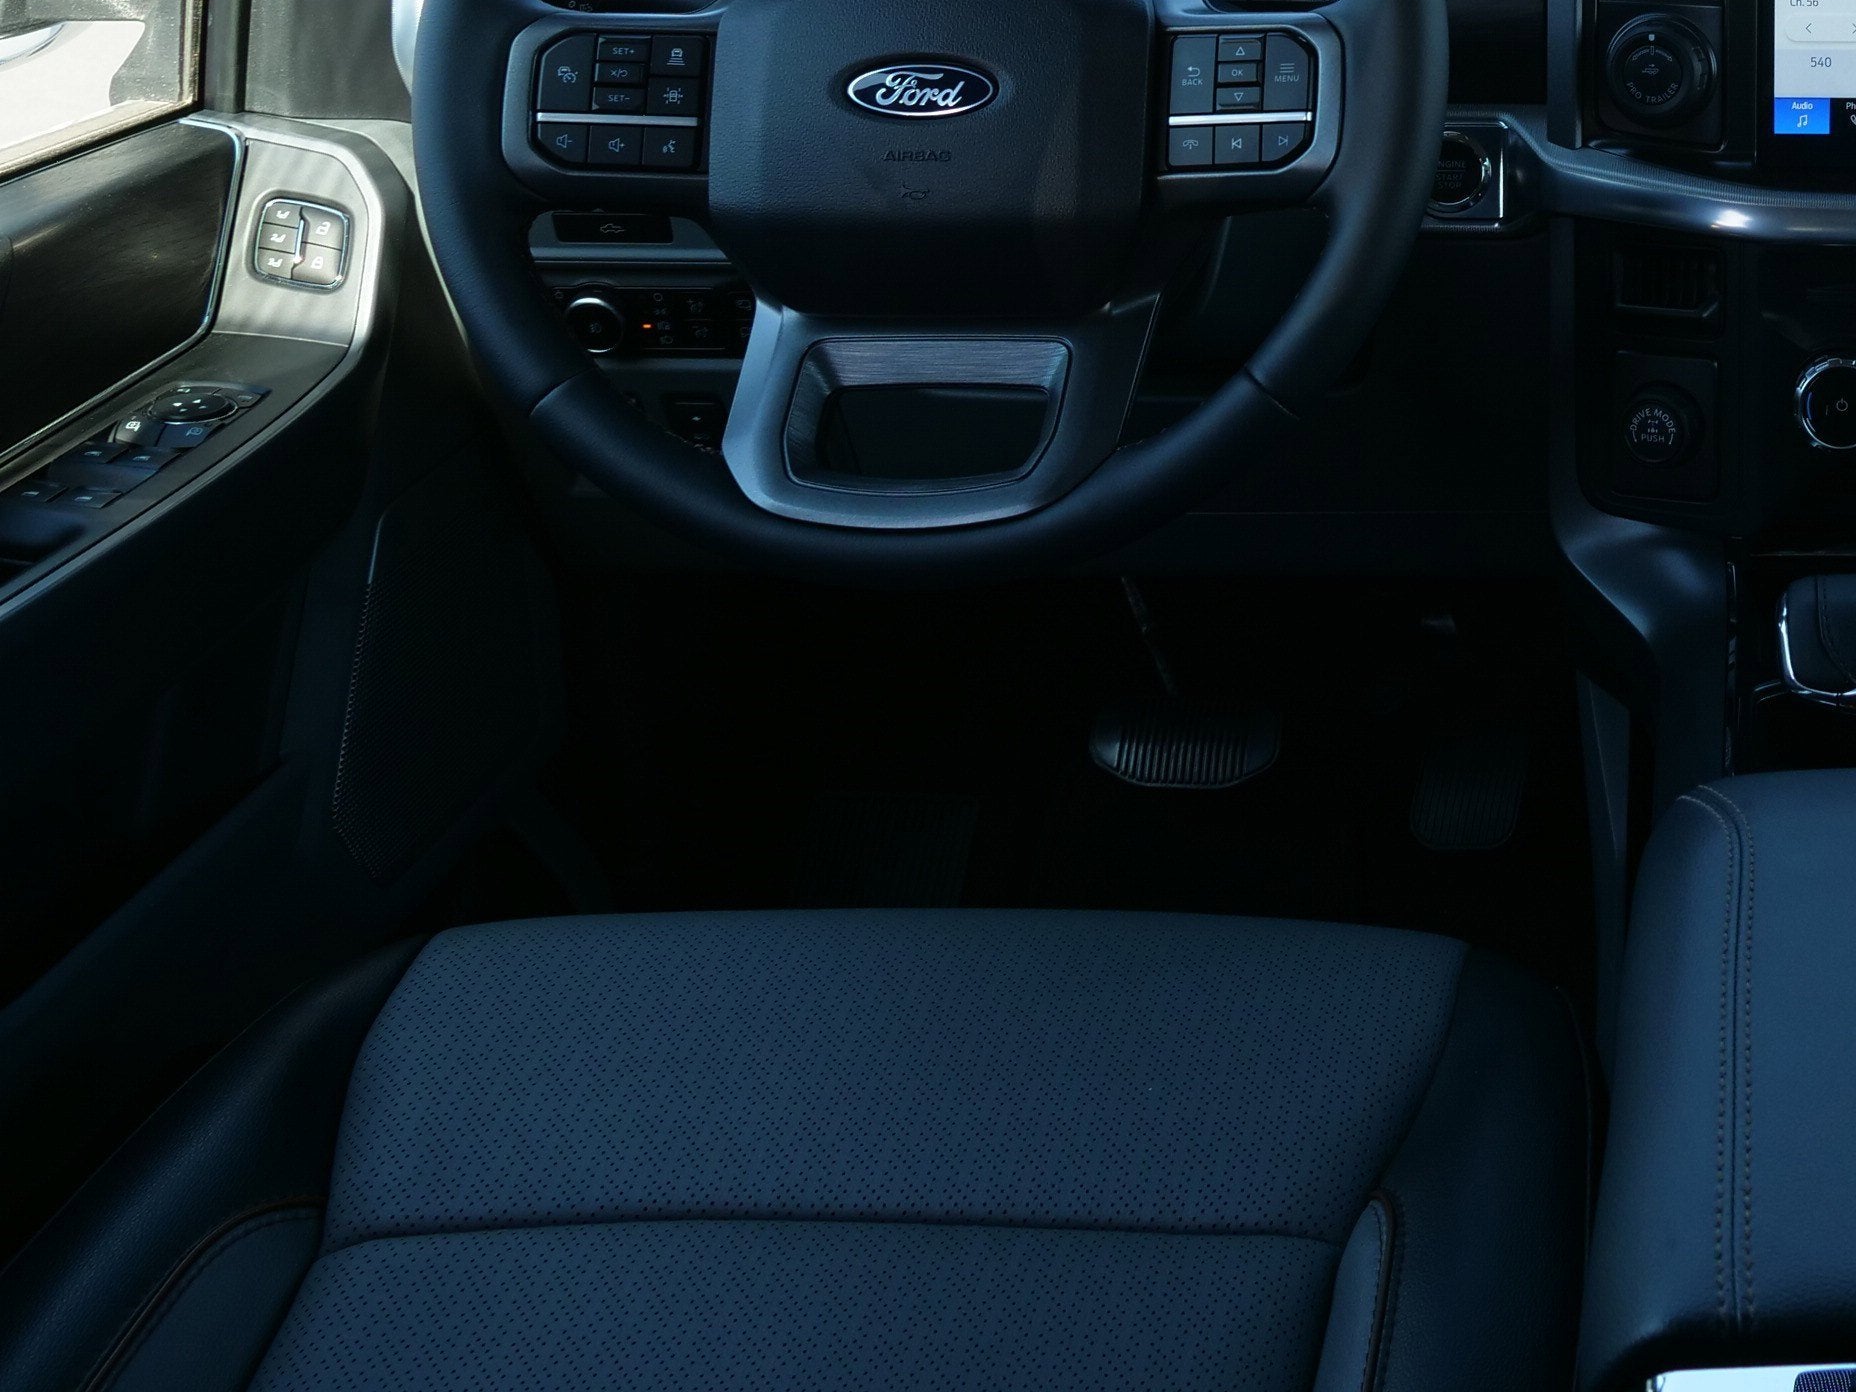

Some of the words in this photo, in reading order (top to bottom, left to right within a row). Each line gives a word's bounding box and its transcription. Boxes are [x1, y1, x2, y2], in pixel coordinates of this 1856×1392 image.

[612, 46, 635, 56] SET+
[1810, 57, 1832, 68] 540
[1231, 68, 1244, 77] OK
[1181, 77, 1204, 88] BACK
[1273, 73, 1300, 84] MENU
[874, 71, 962, 109] Ford
[1646, 81, 1680, 105] TRAILER
[1791, 102, 1814, 111] Audio
[881, 149, 951, 162] AIRBAG
[1629, 407, 1652, 432] DRIVE
[1653, 407, 1677, 434] MODE
[1641, 433, 1665, 444] PUSH
